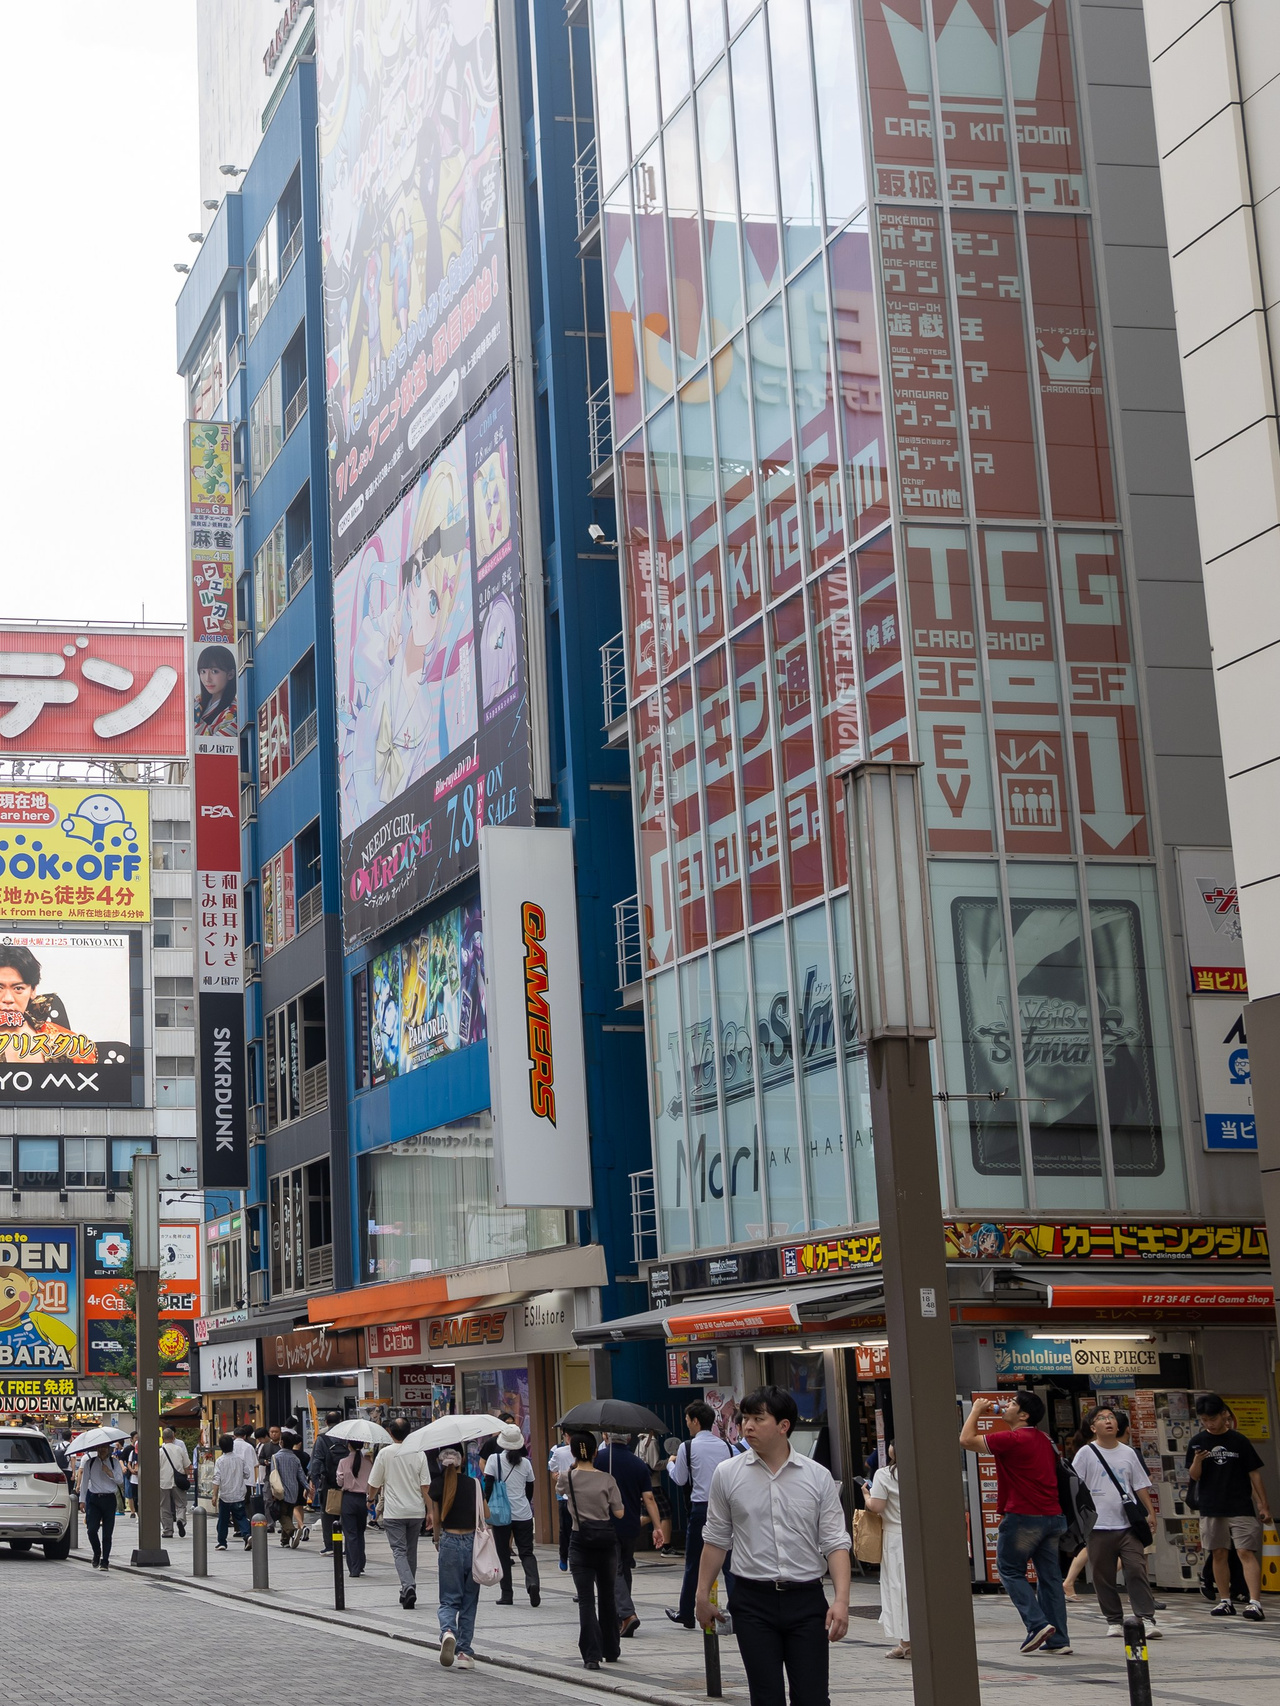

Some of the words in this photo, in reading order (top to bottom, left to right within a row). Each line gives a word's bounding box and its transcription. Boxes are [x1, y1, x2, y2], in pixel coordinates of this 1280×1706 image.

[970, 121, 1072, 146] KINGDOM
[881, 226, 1000, 257] ポケモン
[888, 313, 985, 342] 遊戯王
[891, 354, 990, 384] デュエマ
[894, 388, 950, 401] VANGUARD
[895, 401, 992, 431] ヴァンガ
[903, 487, 962, 510] その他
[906, 526, 1122, 627] TCG
[914, 628, 974, 650] CARD
[986, 631, 1046, 651] SHOP
[917, 660, 978, 697] 3F
[487, 762, 504, 798] ON
[0, 793, 47, 809] 現在地
[0, 811, 19, 821] are
[22, 810, 50, 821] here
[487, 786, 517, 827] SALE
[361, 829, 393, 870] NEEDY
[393, 813, 416, 838] GIRL
[10, 906, 37, 917] from
[39, 906, 63, 917] here
[201, 873, 218, 967] もみほぐし
[221, 873, 238, 967] 和風耳かき
[13, 936, 44, 947] 毎週火曜
[45, 937, 68, 947] 21:25
[70, 938, 101, 947] TOKYO
[520, 900, 558, 1129] GAMERS
[408, 1015, 448, 1049] PALWORLD
[41, 1072, 99, 1092] MX
[213, 1027, 234, 1152] SNKRDUNK
[14, 1232, 28, 1243] to
[86, 1227, 98, 1237] 5F
[1063, 1225, 1269, 1257] カードキングダム
[35, 1280, 68, 1314] 迎
[87, 1294, 101, 1306] 4F
[1142, 1295, 1153, 1303] 1F
[1154, 1295, 1165, 1303] 2F
[1166, 1295, 1177, 1303] 3F
[1178, 1295, 1191, 1303] 4F
[1194, 1295, 1216, 1303] Card
[1217, 1295, 1245, 1304] Game
[1246, 1295, 1270, 1305] Shop
[428, 1312, 508, 1350] GAMERS
[1012, 1350, 1071, 1365] hololive
[1113, 1350, 1157, 1366] PIECE
[8, 1380, 40, 1395] FREE
[43, 1379, 75, 1396] 免税
